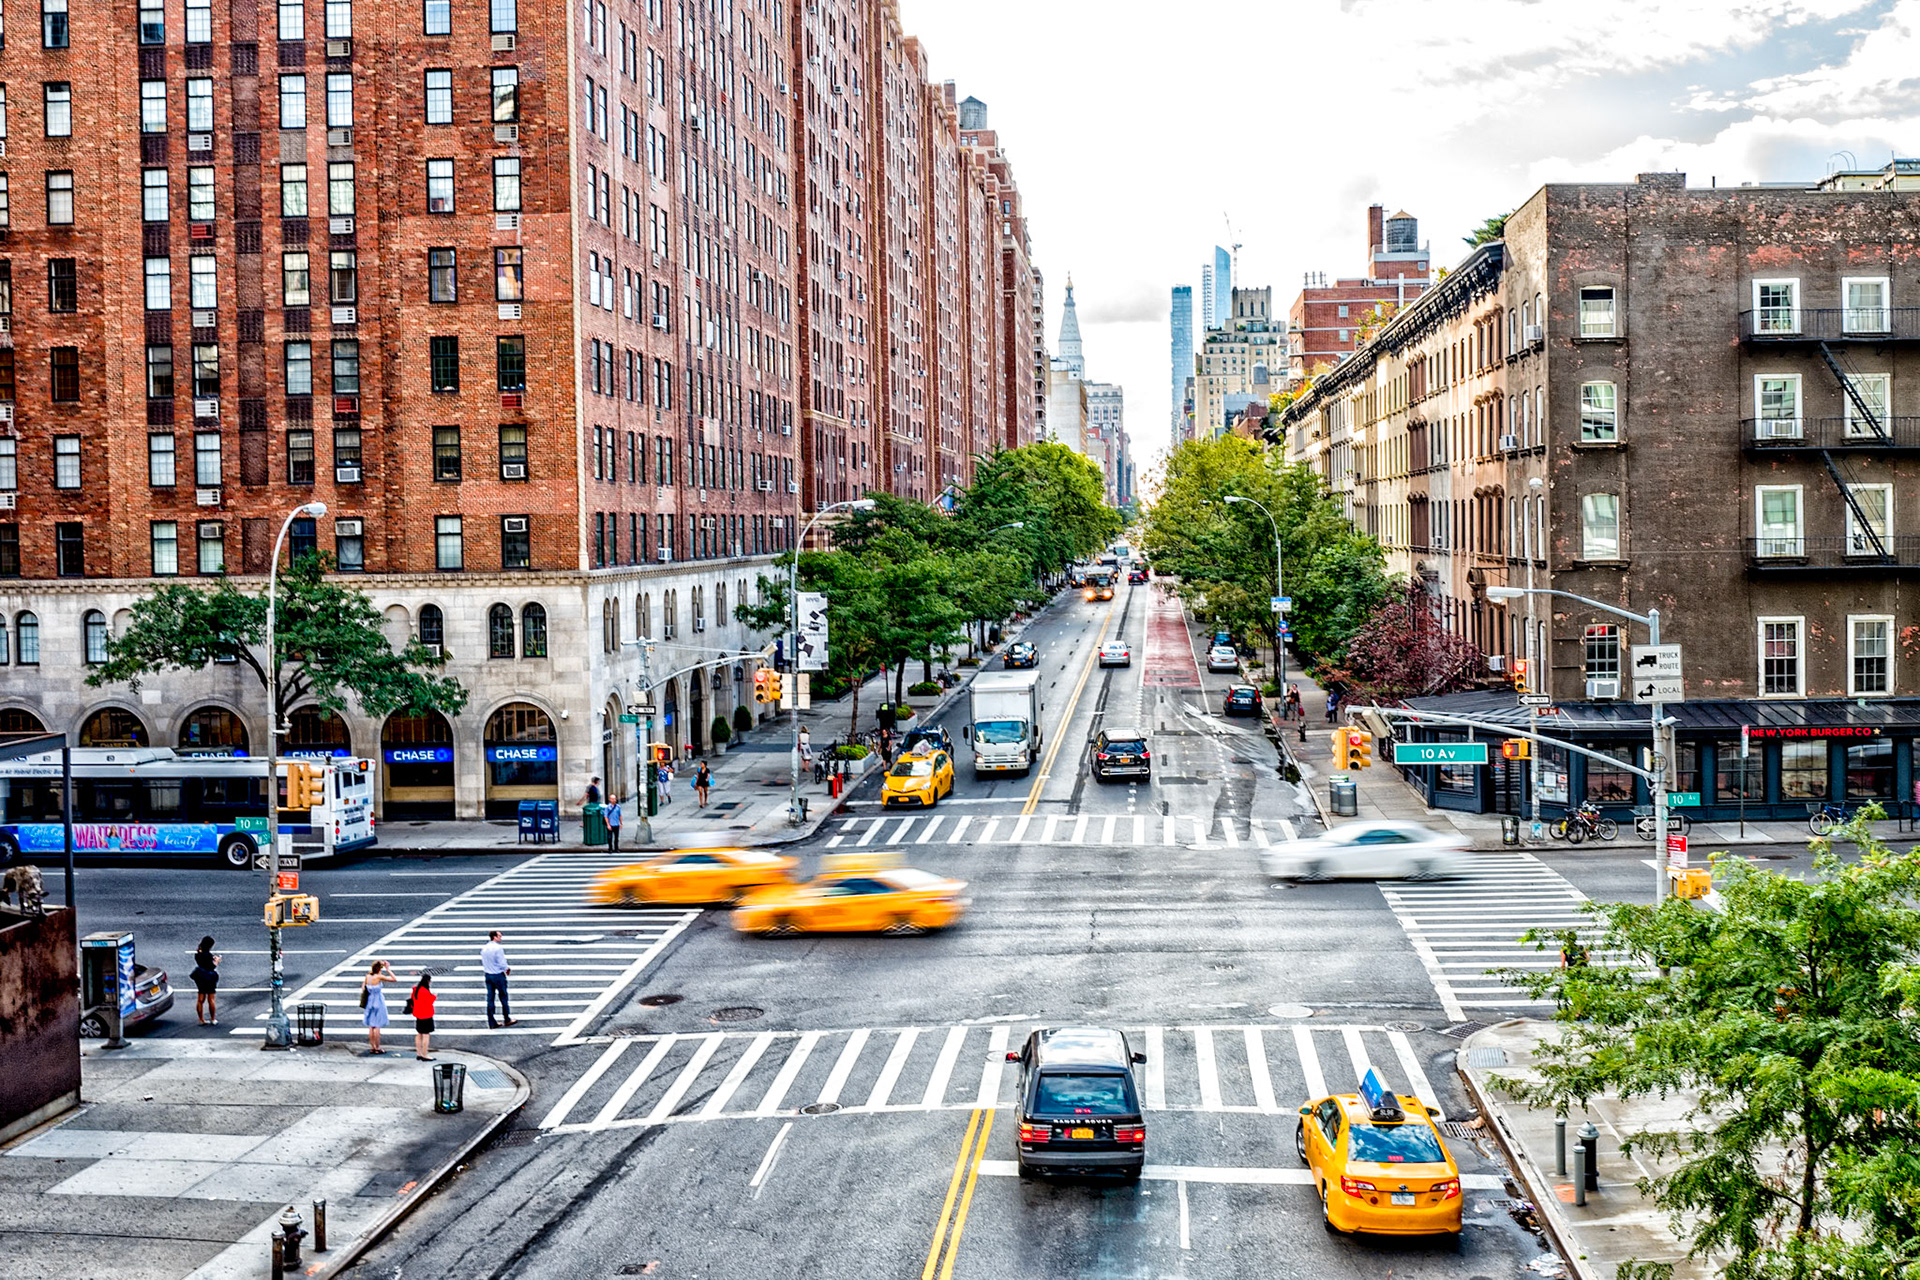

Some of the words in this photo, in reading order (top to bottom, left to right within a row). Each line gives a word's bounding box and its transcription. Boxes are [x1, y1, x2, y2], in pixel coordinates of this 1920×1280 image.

[1750, 729, 1777, 737] NEW
[1780, 728, 1809, 737] YORK
[1811, 728, 1853, 737] BURGER
[1855, 727, 1871, 736] CO
[393, 750, 435, 761] CHASE
[495, 749, 537, 759] CHASE
[1421, 748, 1434, 759] 10
[1438, 748, 1456, 759] Av
[1672, 795, 1683, 804] 10
[240, 819, 251, 828] 10
[1642, 821, 1656, 829] ONE
